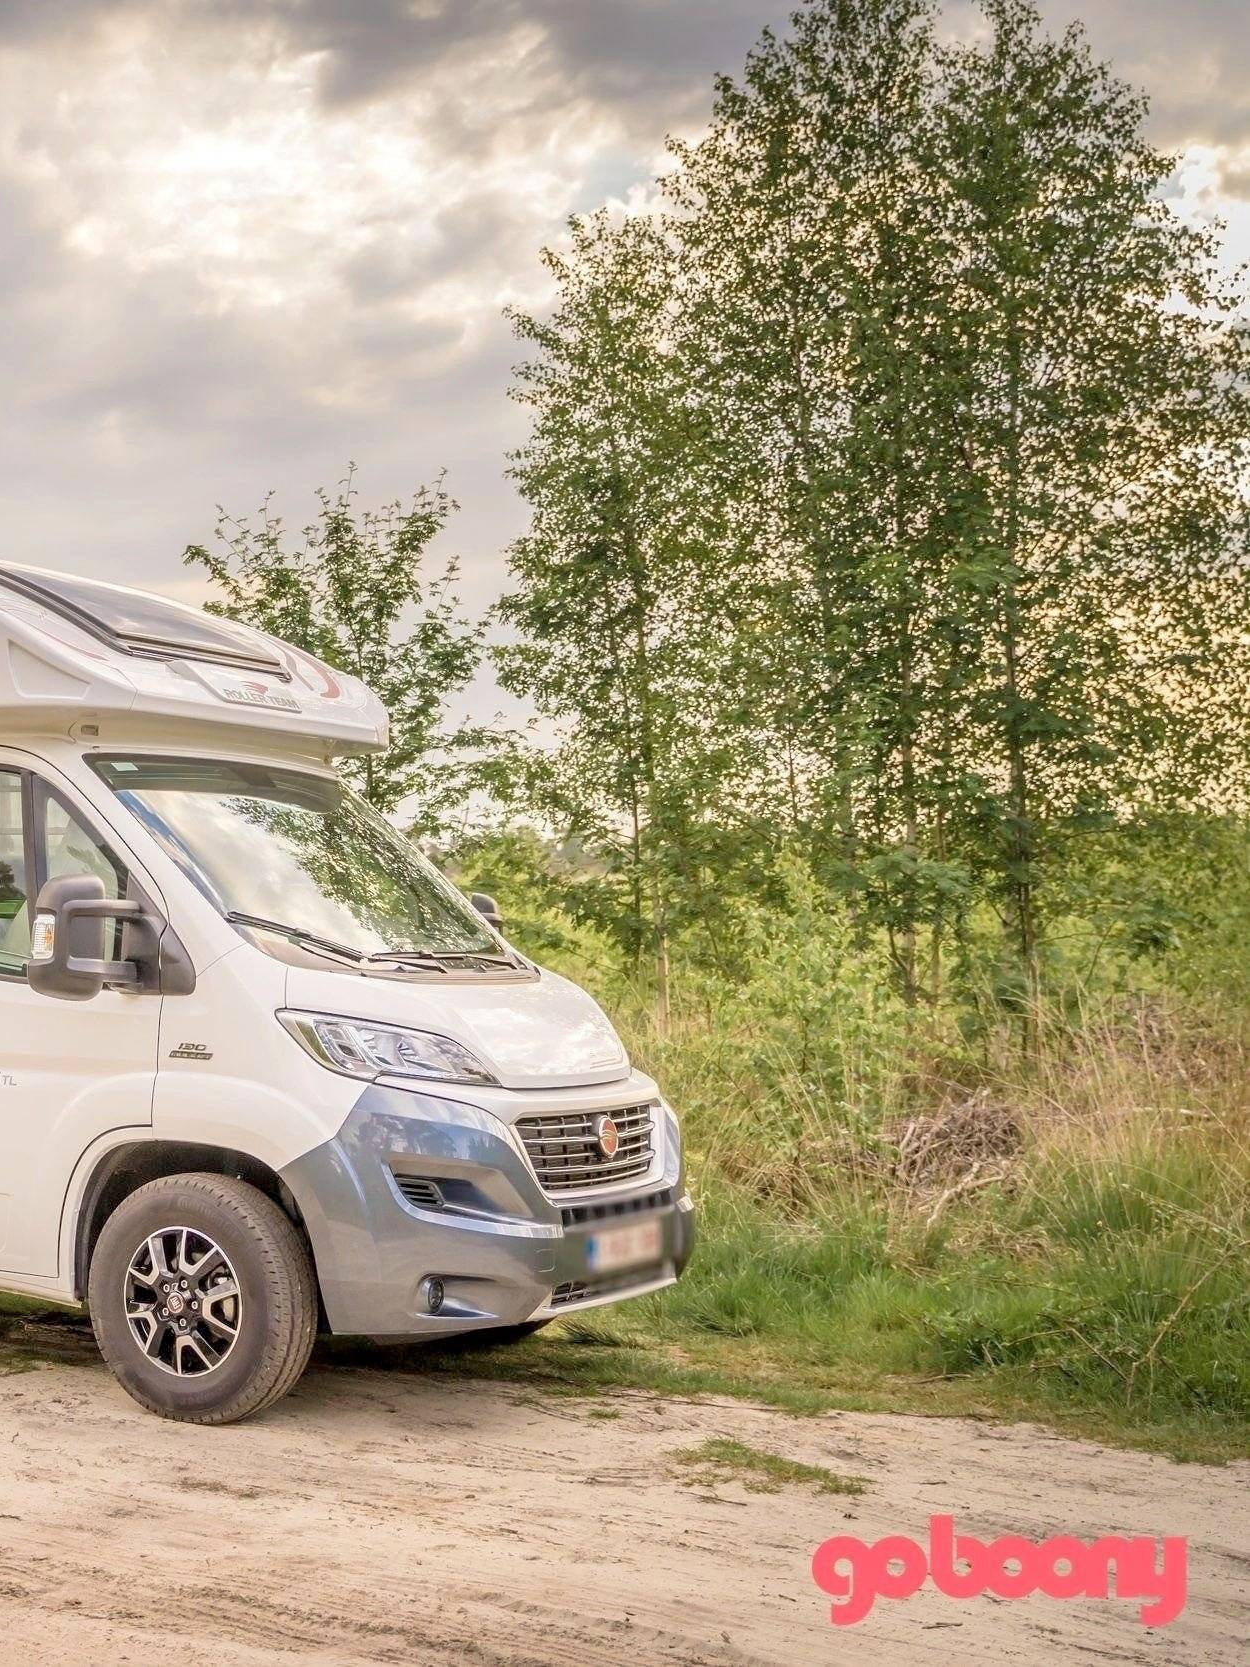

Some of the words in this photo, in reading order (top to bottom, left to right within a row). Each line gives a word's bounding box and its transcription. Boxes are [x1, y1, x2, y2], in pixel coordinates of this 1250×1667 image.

[223, 688, 267, 704] ROLLER
[267, 695, 300, 709] TEAM
[178, 1042, 207, 1051] 130
